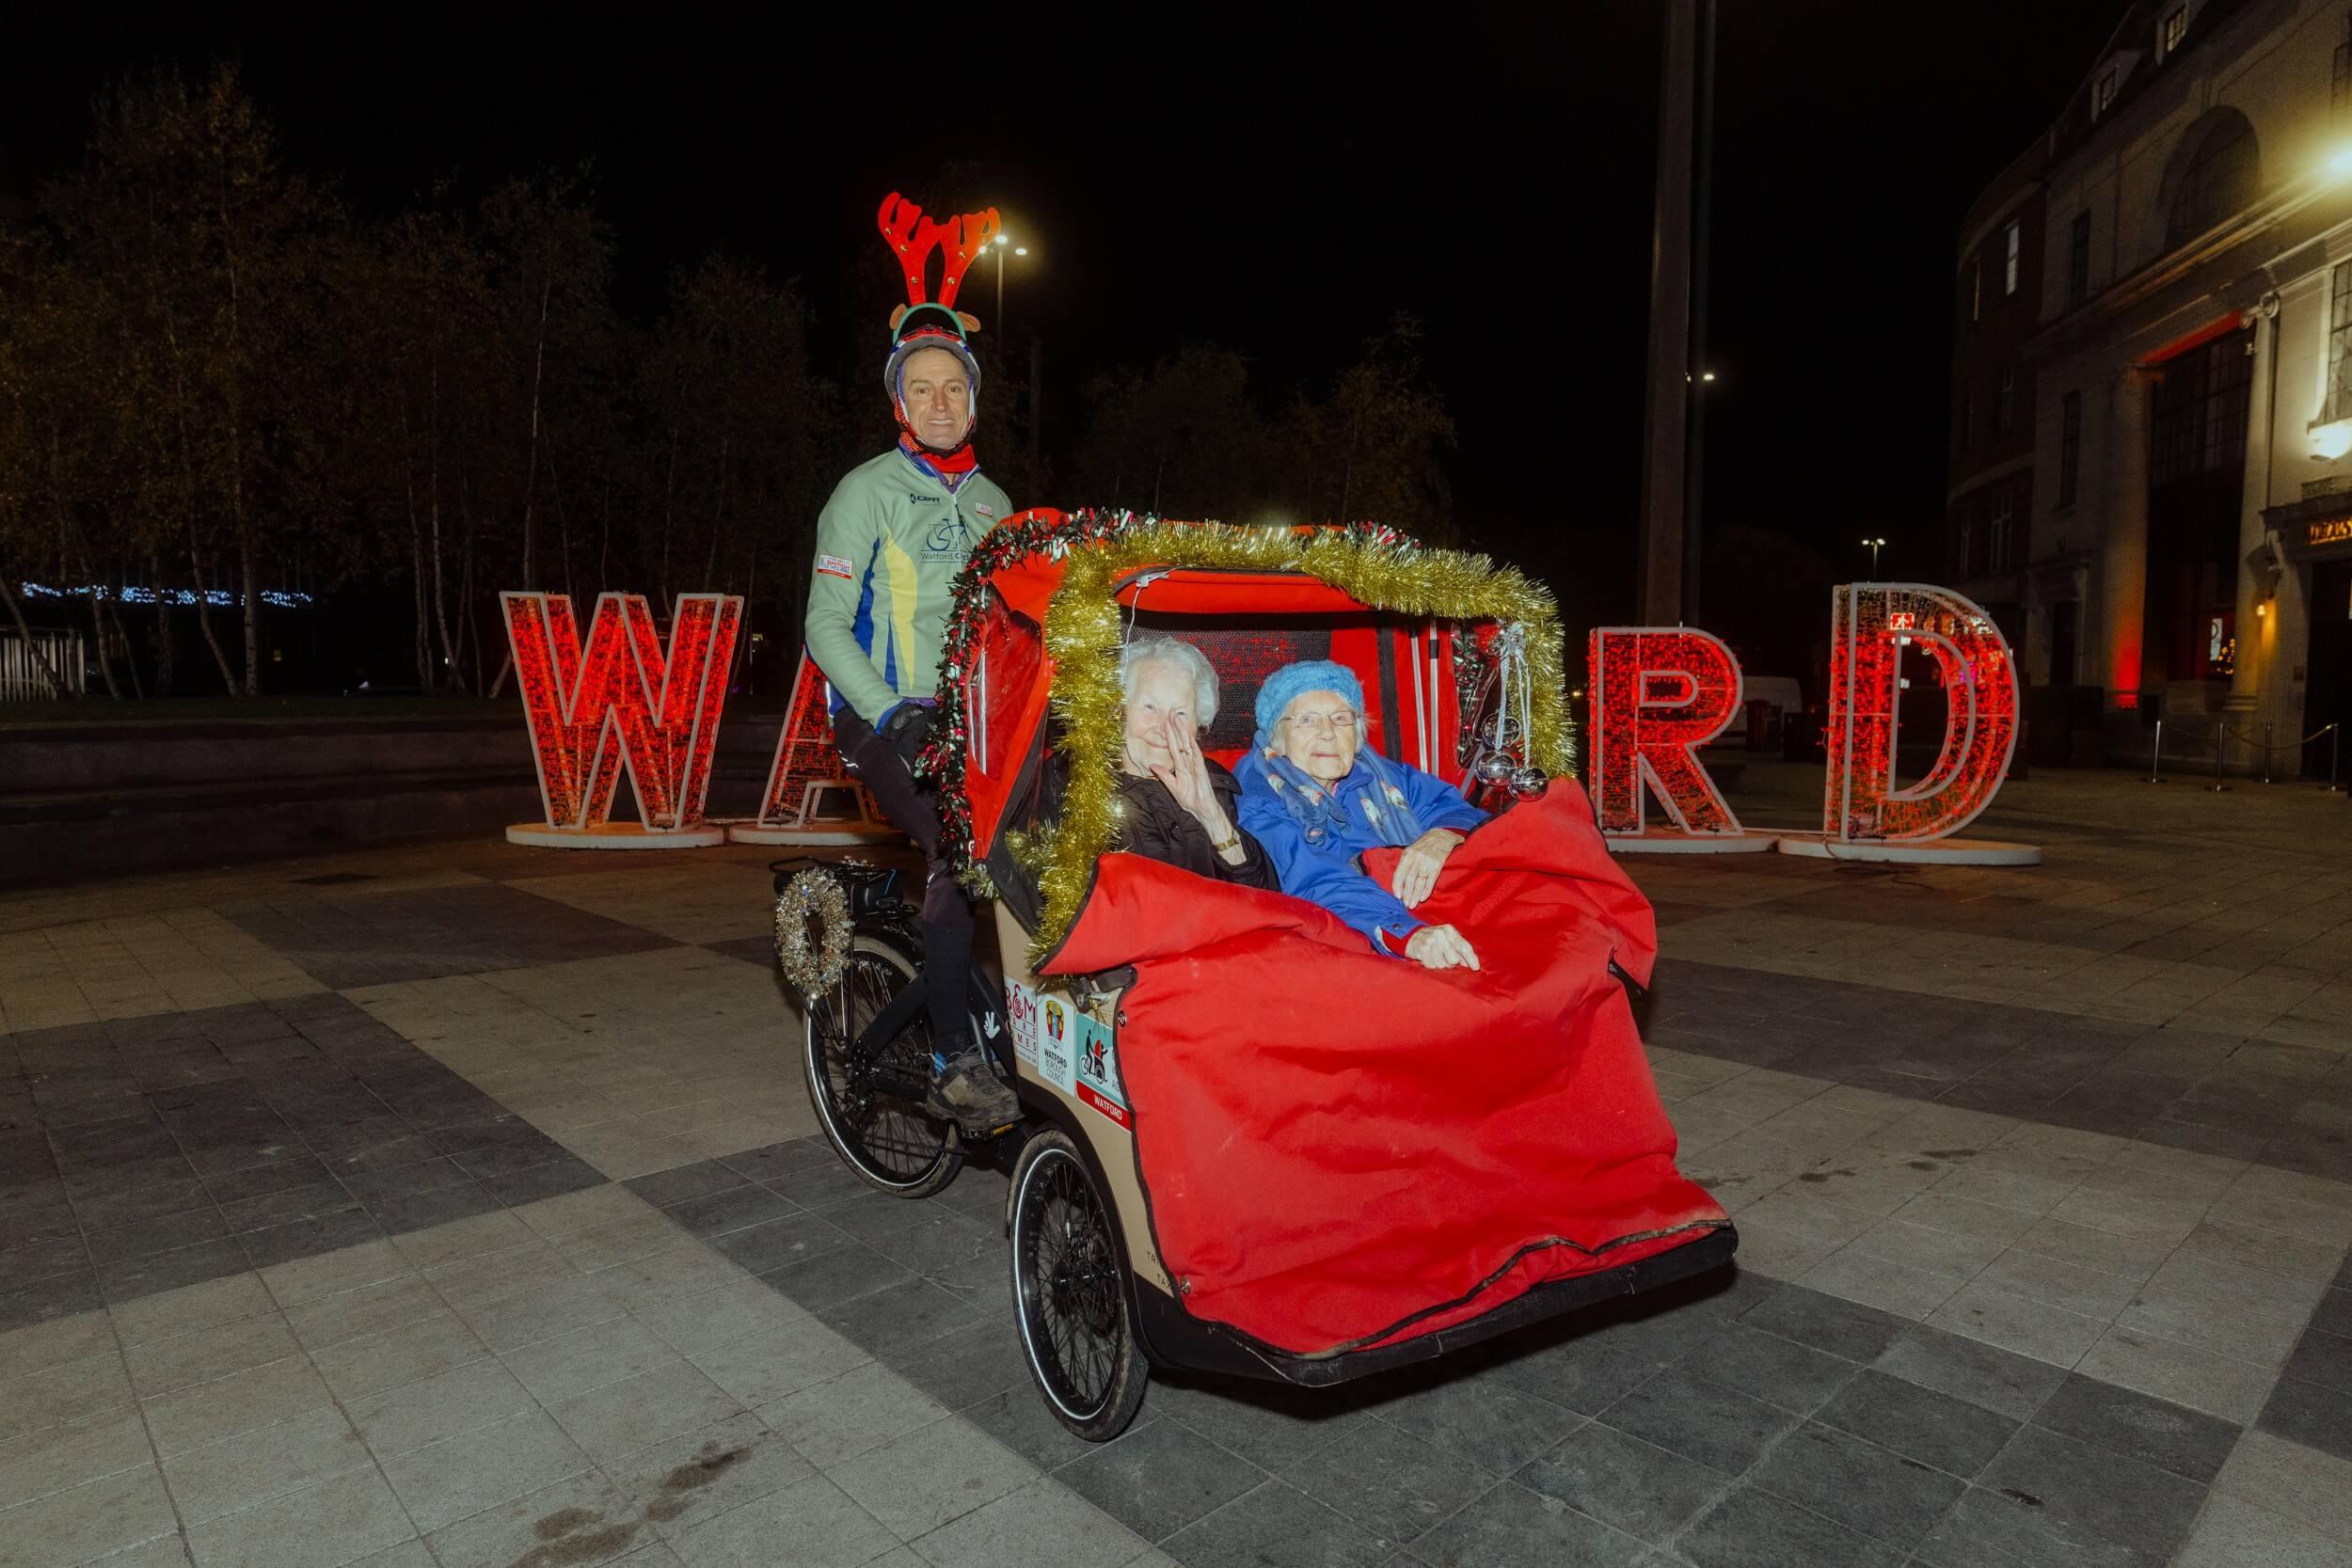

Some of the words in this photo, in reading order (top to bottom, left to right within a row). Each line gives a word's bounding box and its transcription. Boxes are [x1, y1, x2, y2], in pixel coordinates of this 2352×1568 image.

[955, 552, 969, 562] Ccl
[1044, 1047, 1068, 1069] WATFORD
[1045, 1057, 1066, 1075] BOROUGH
[1047, 1068, 1065, 1085] COUNCIL
[1093, 1094, 1122, 1120] WATFORD
[1146, 1250, 1159, 1264] TRI
[1156, 1274, 1170, 1289] TAX
